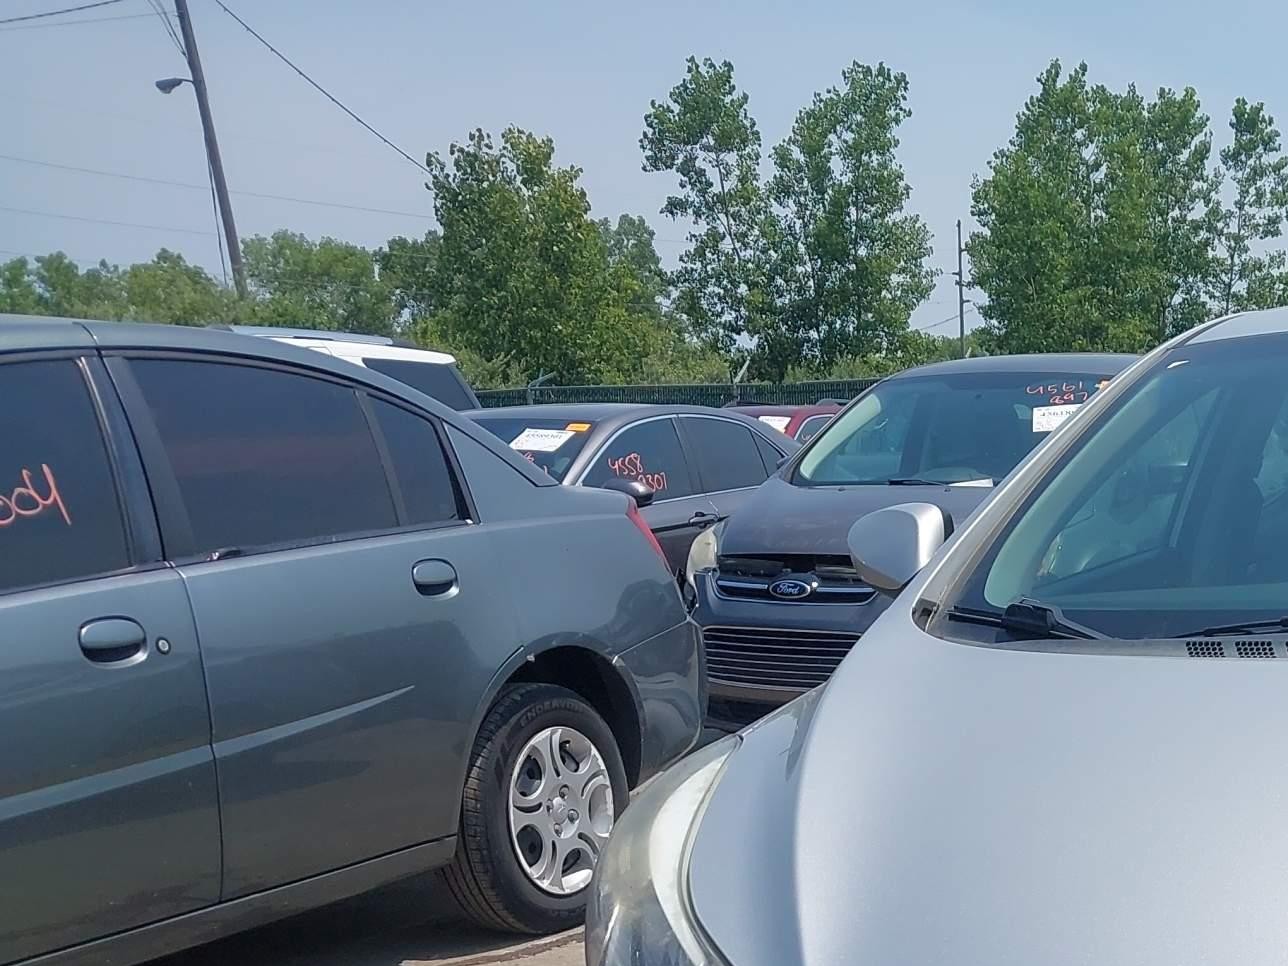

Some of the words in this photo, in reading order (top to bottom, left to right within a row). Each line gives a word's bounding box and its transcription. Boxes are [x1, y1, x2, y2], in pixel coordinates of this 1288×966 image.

[1026, 381, 1083, 395] 4561
[608, 452, 644, 476] 4558
[776, 582, 800, 595] Ford
